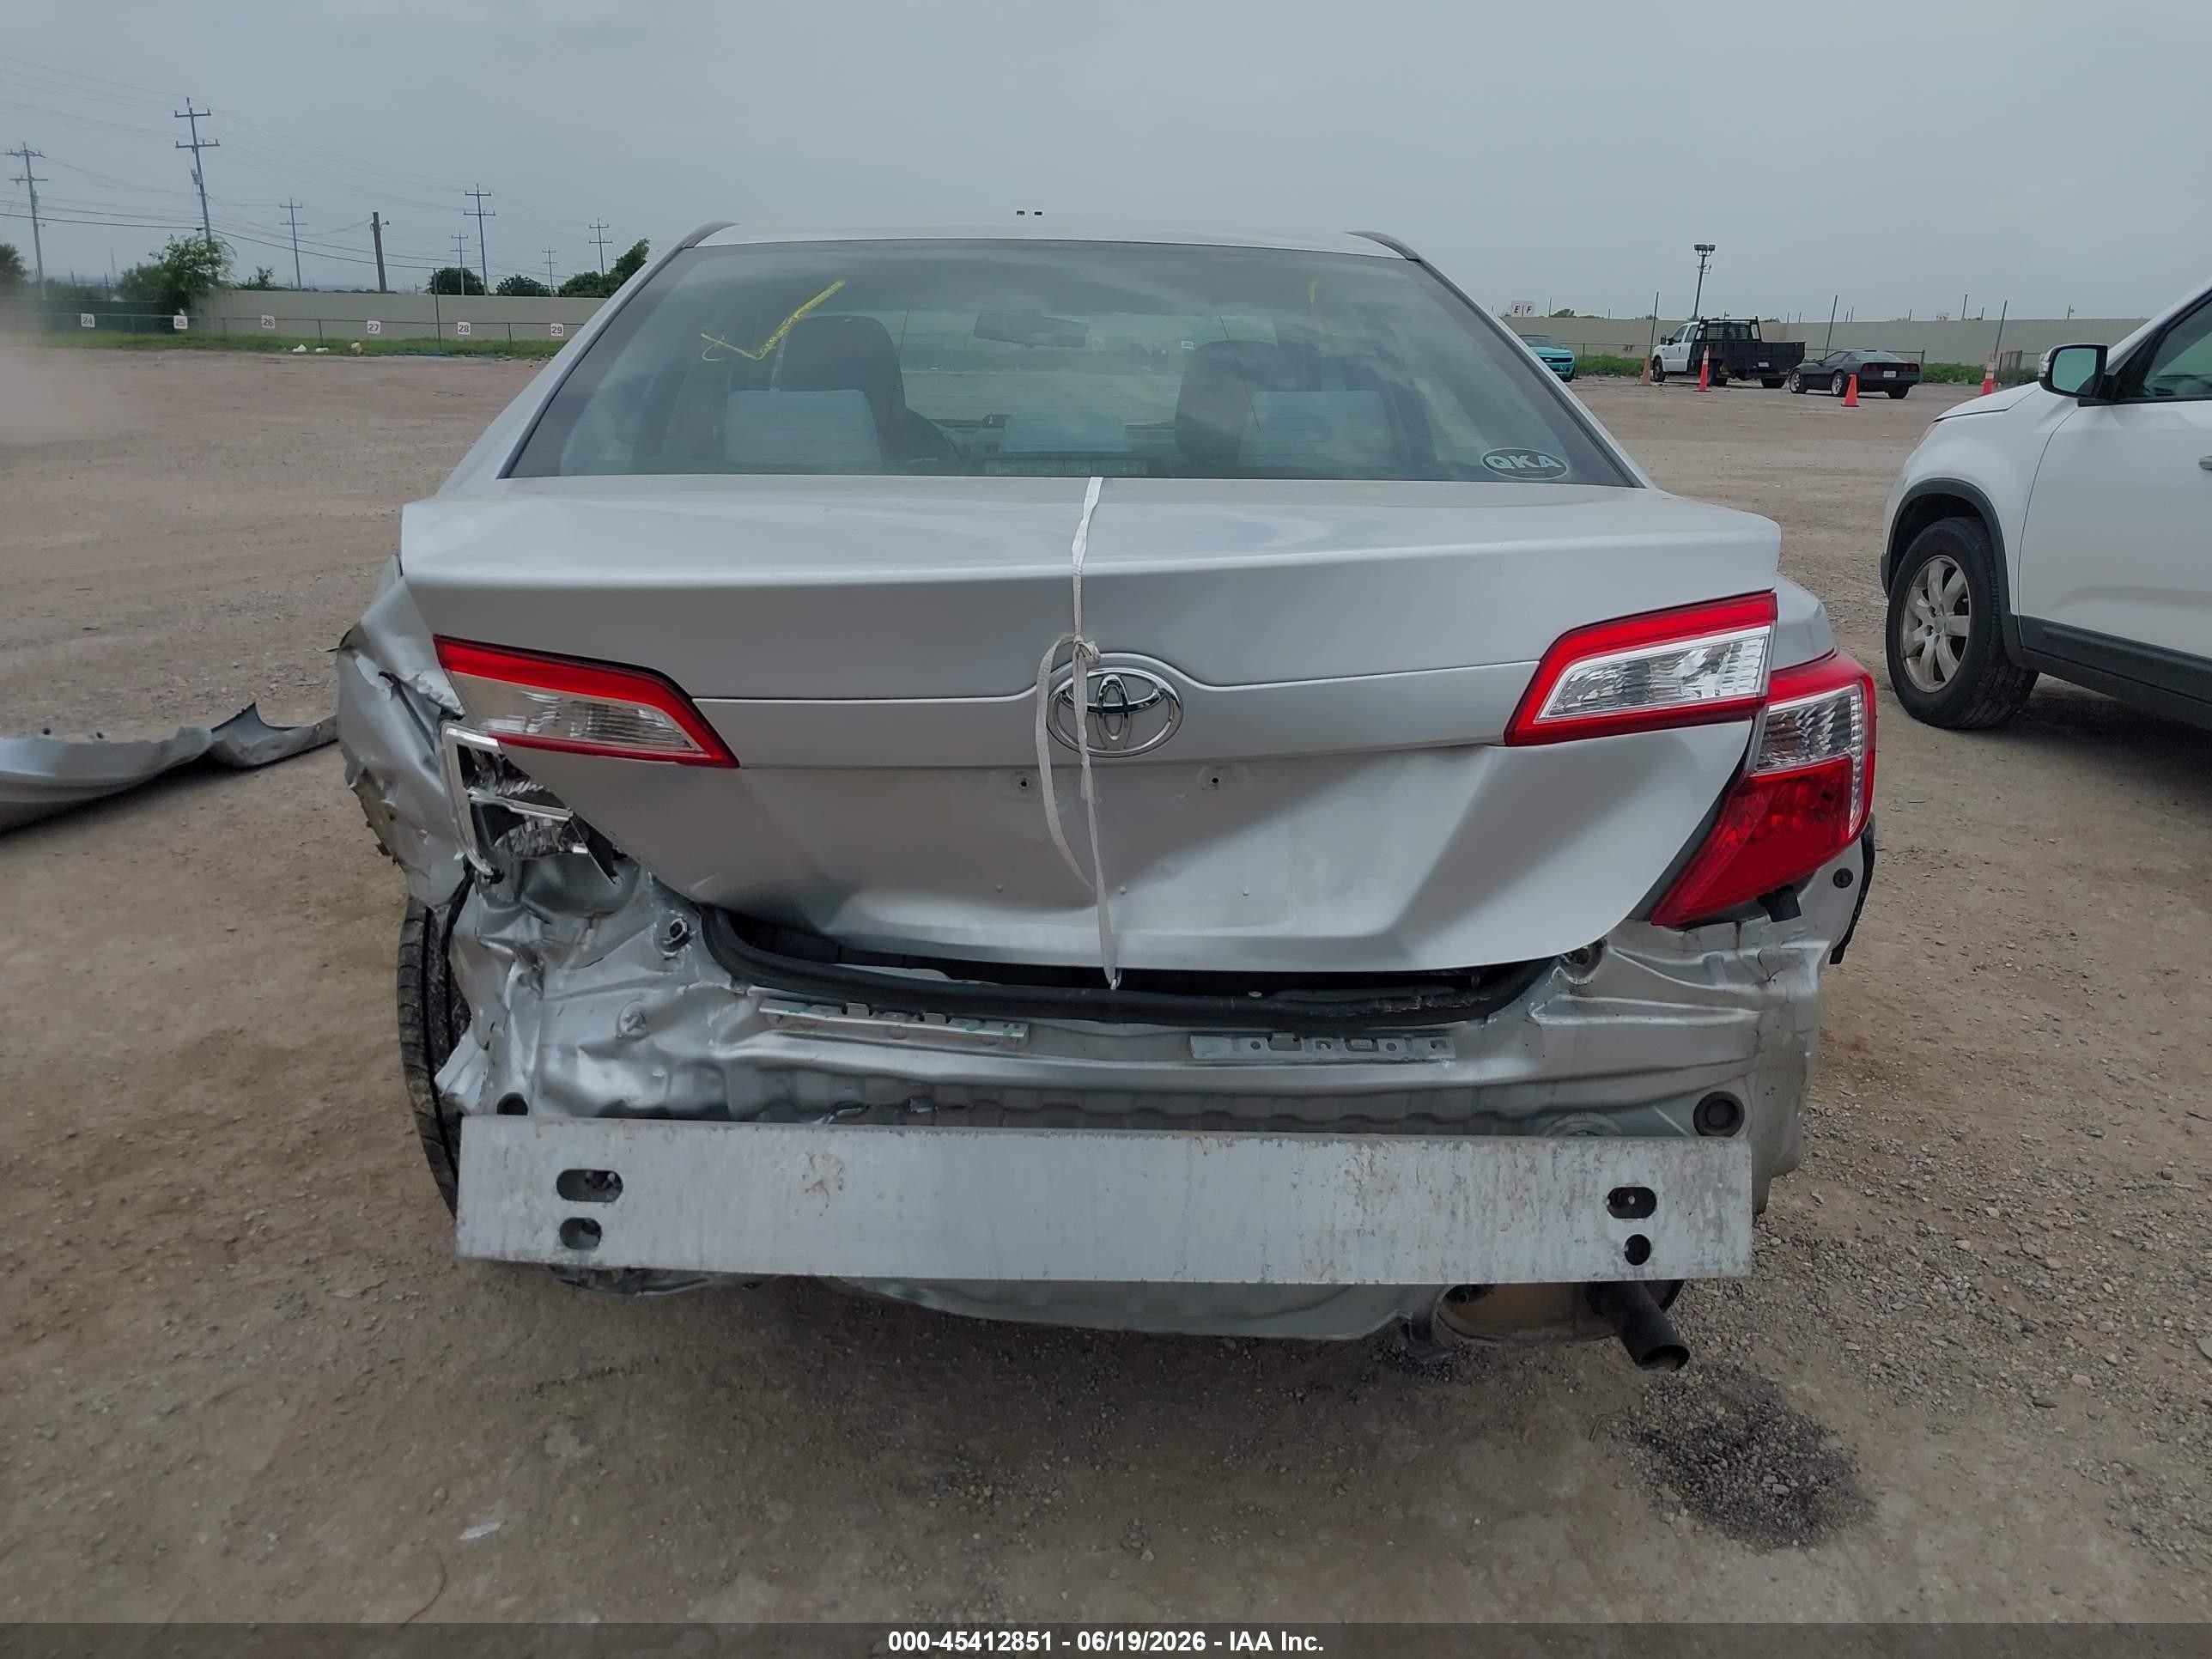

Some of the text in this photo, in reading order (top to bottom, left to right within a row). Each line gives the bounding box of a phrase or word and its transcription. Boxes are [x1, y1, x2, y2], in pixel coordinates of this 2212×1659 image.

[1514, 305, 1520, 313] E
[82, 316, 94, 325] 24
[263, 318, 274, 327] 26
[368, 323, 380, 331] 27
[459, 325, 470, 333] 28
